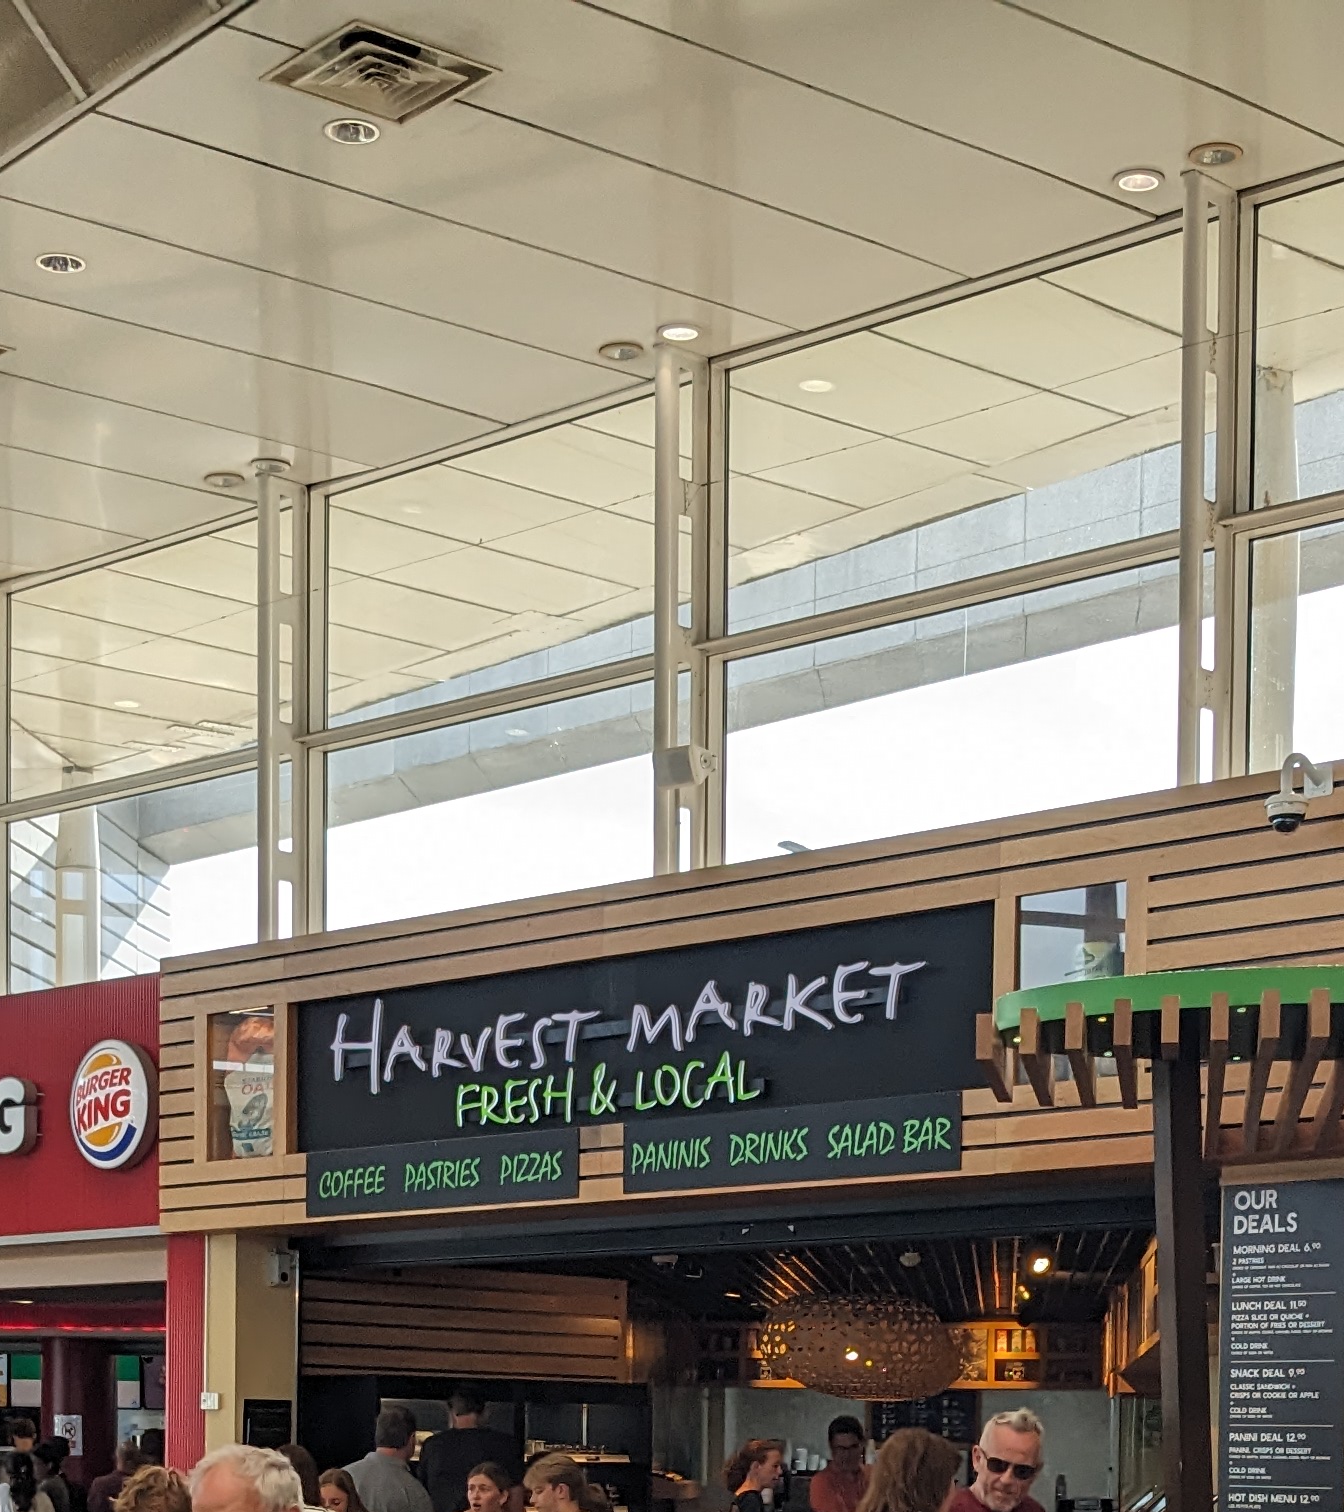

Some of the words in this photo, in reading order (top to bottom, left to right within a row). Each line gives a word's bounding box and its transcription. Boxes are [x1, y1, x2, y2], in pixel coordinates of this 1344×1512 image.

[330, 998, 601, 1095] HARVEST
[626, 960, 927, 1053] MARKET
[76, 1067, 132, 1107] BURGER
[457, 1068, 575, 1128] FRESH
[578, 1062, 617, 1115] &
[635, 1050, 762, 1111] LOCAL
[76, 1088, 132, 1136] KING
[631, 1135, 711, 1174] PANINIS
[729, 1125, 809, 1165] DRINKS
[827, 1119, 896, 1159] SALAD
[902, 1116, 953, 1153] BAR
[319, 1164, 386, 1199] COFFEE
[404, 1156, 480, 1192] PASTRIES
[500, 1150, 563, 1185] PIZZAS
[1234, 1189, 1278, 1211] OUR
[1233, 1212, 1298, 1235] DEALS
[1233, 1244, 1275, 1255] MORNING
[1278, 1243, 1301, 1253] DEAL
[1232, 1276, 1252, 1284] LARGE
[1232, 1301, 1261, 1311] LUNCH
[1264, 1301, 1287, 1310] DEAL
[1230, 1369, 1260, 1378] SNACK
[1262, 1369, 1286, 1378] DEAL
[1229, 1433, 1258, 1442] PANINI
[1260, 1433, 1284, 1442] DEAL
[1228, 1494, 1246, 1503] HOT
[1248, 1494, 1268, 1503] DISH
[1270, 1495, 1298, 1504] MENU
